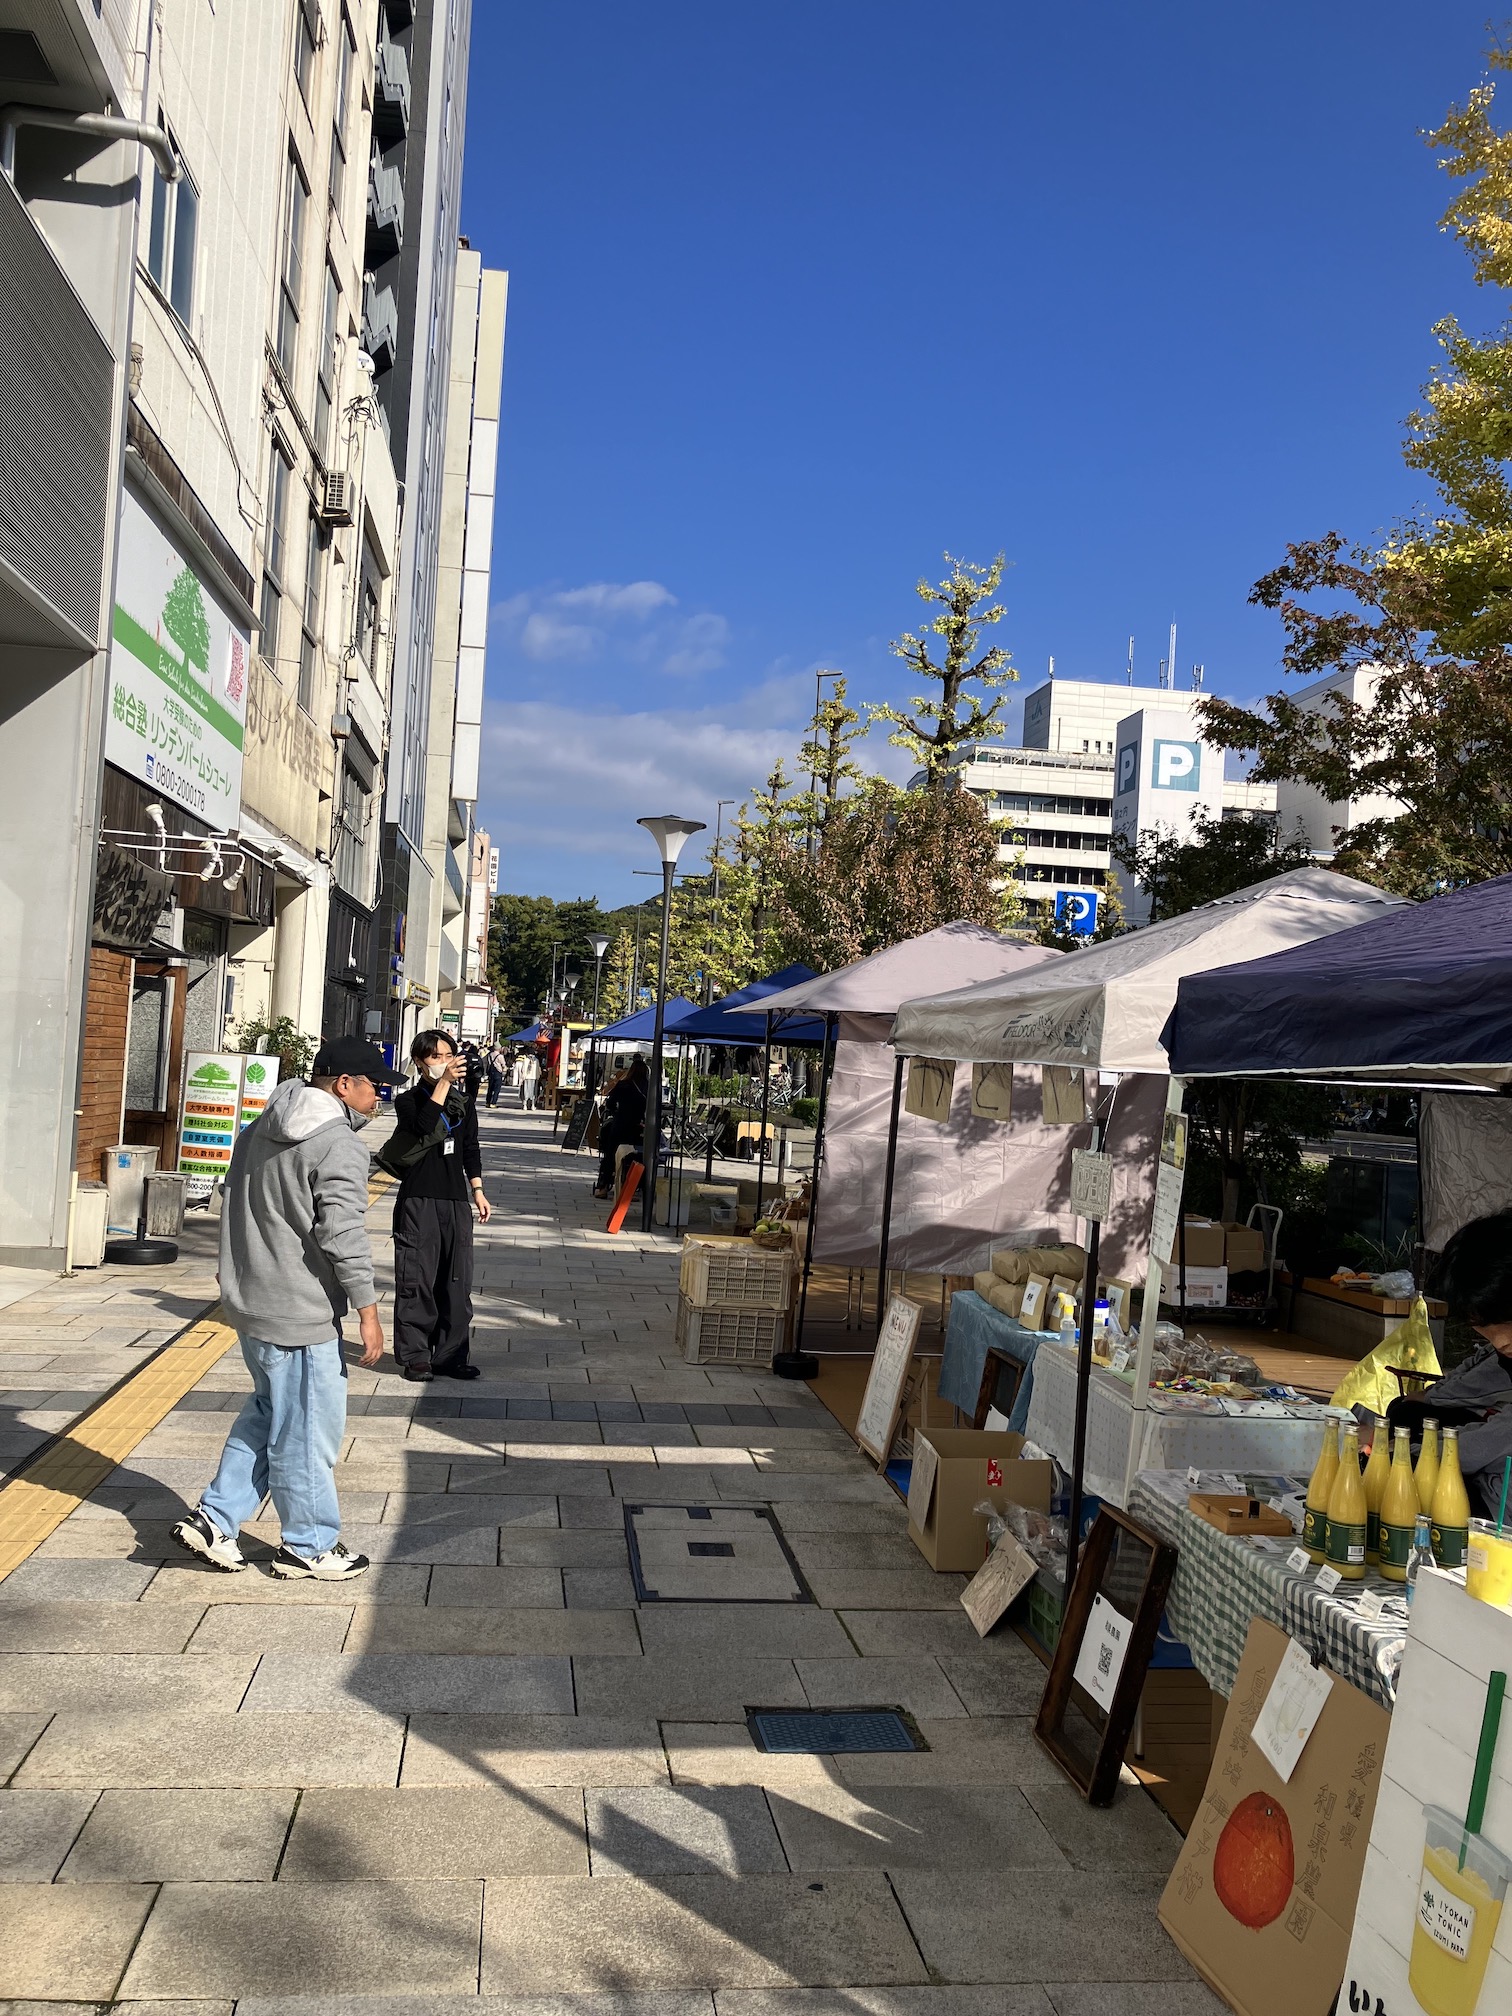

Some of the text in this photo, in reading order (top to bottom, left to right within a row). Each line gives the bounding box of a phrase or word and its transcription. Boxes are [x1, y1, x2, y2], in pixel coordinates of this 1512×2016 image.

[151, 713, 232, 797] リンデンバームシューレ
[1158, 744, 1194, 785] P
[1120, 749, 1135, 792] P
[156, 762, 206, 812] 0800-2000178
[189, 1105, 230, 1114] 大学受験専門
[188, 1119, 229, 1129] 理科社会対応
[188, 1134, 224, 1144] 自習室完備
[1437, 1914, 1462, 1939] TONIC
[1439, 1901, 1469, 1928] IYOKAN
[1433, 1928, 1449, 1948] IZUMI
